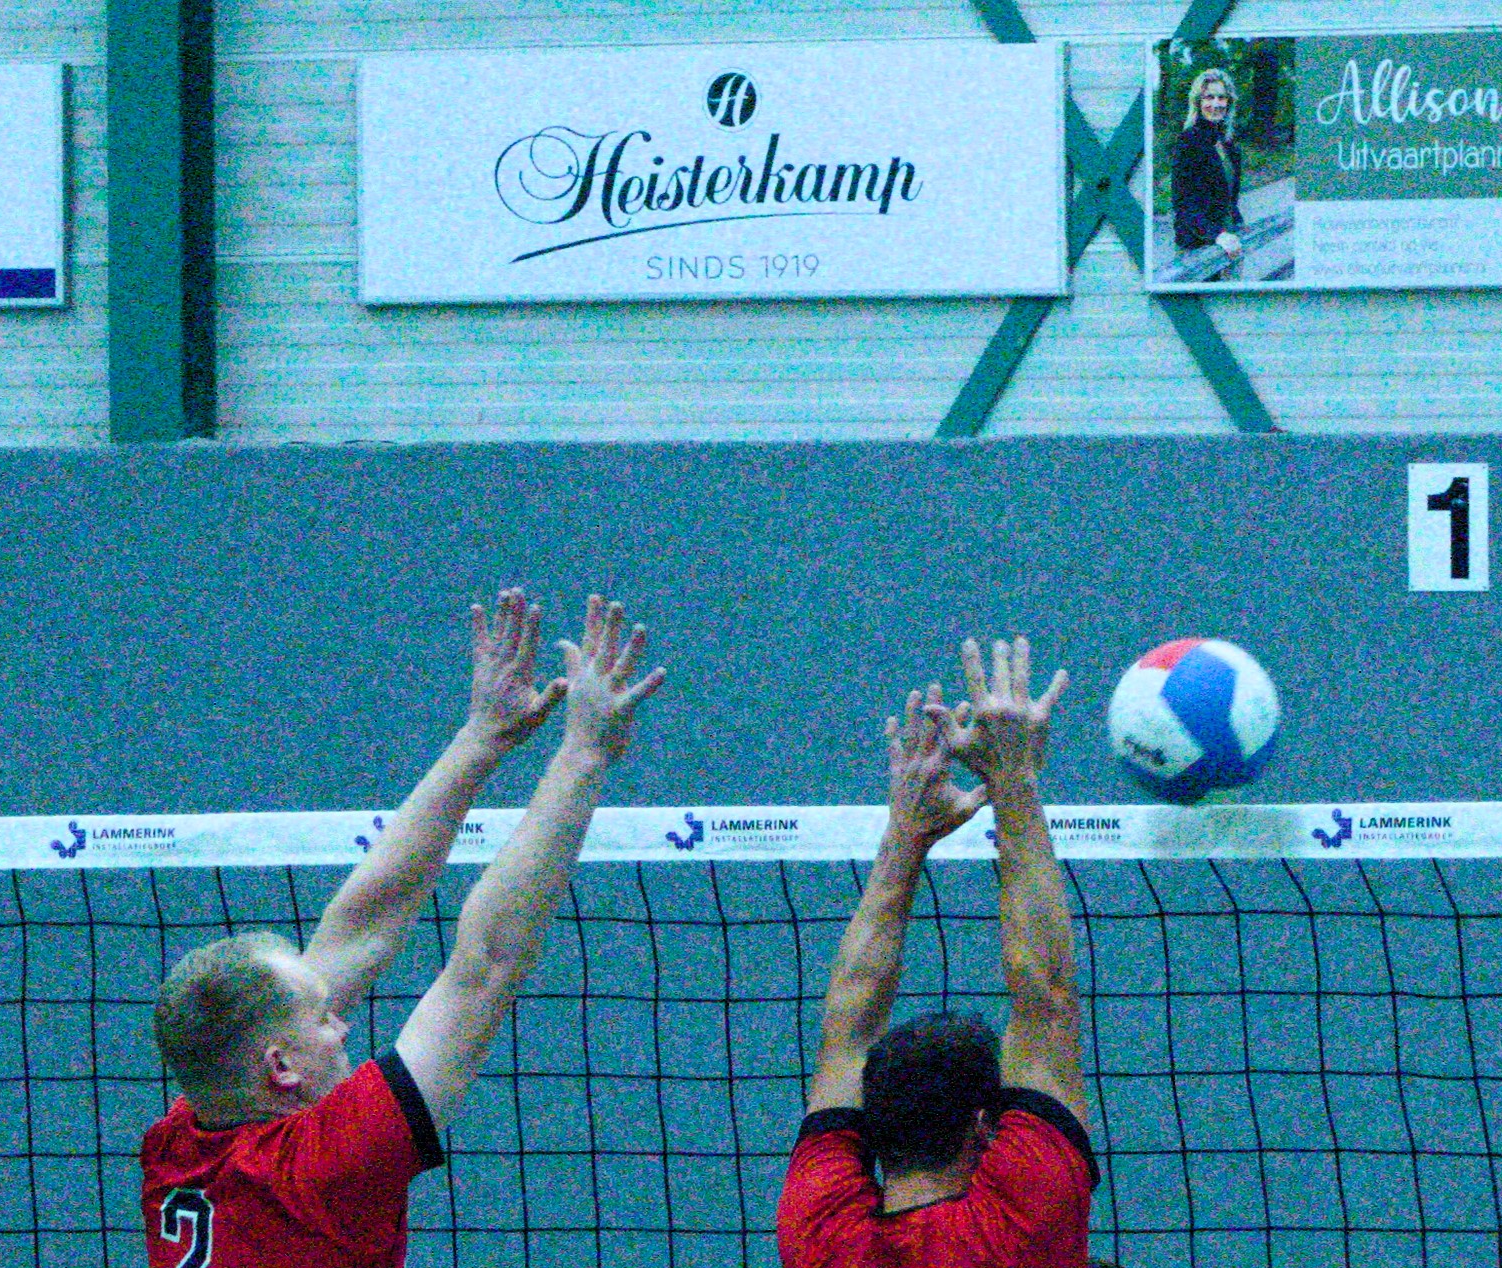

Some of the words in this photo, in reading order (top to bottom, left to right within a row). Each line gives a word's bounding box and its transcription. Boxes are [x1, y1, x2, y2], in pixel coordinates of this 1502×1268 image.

[494, 125, 923, 227] Heisterkamp
[646, 255, 746, 280] SINDS
[759, 254, 820, 279] 1919
[1427, 476, 1470, 579] 1
[711, 819, 798, 831] LAMMERINK
[1050, 818, 1121, 829] MMERINK
[1359, 816, 1452, 828] LAMMERINK
[92, 828, 175, 839] LAMMERINK
